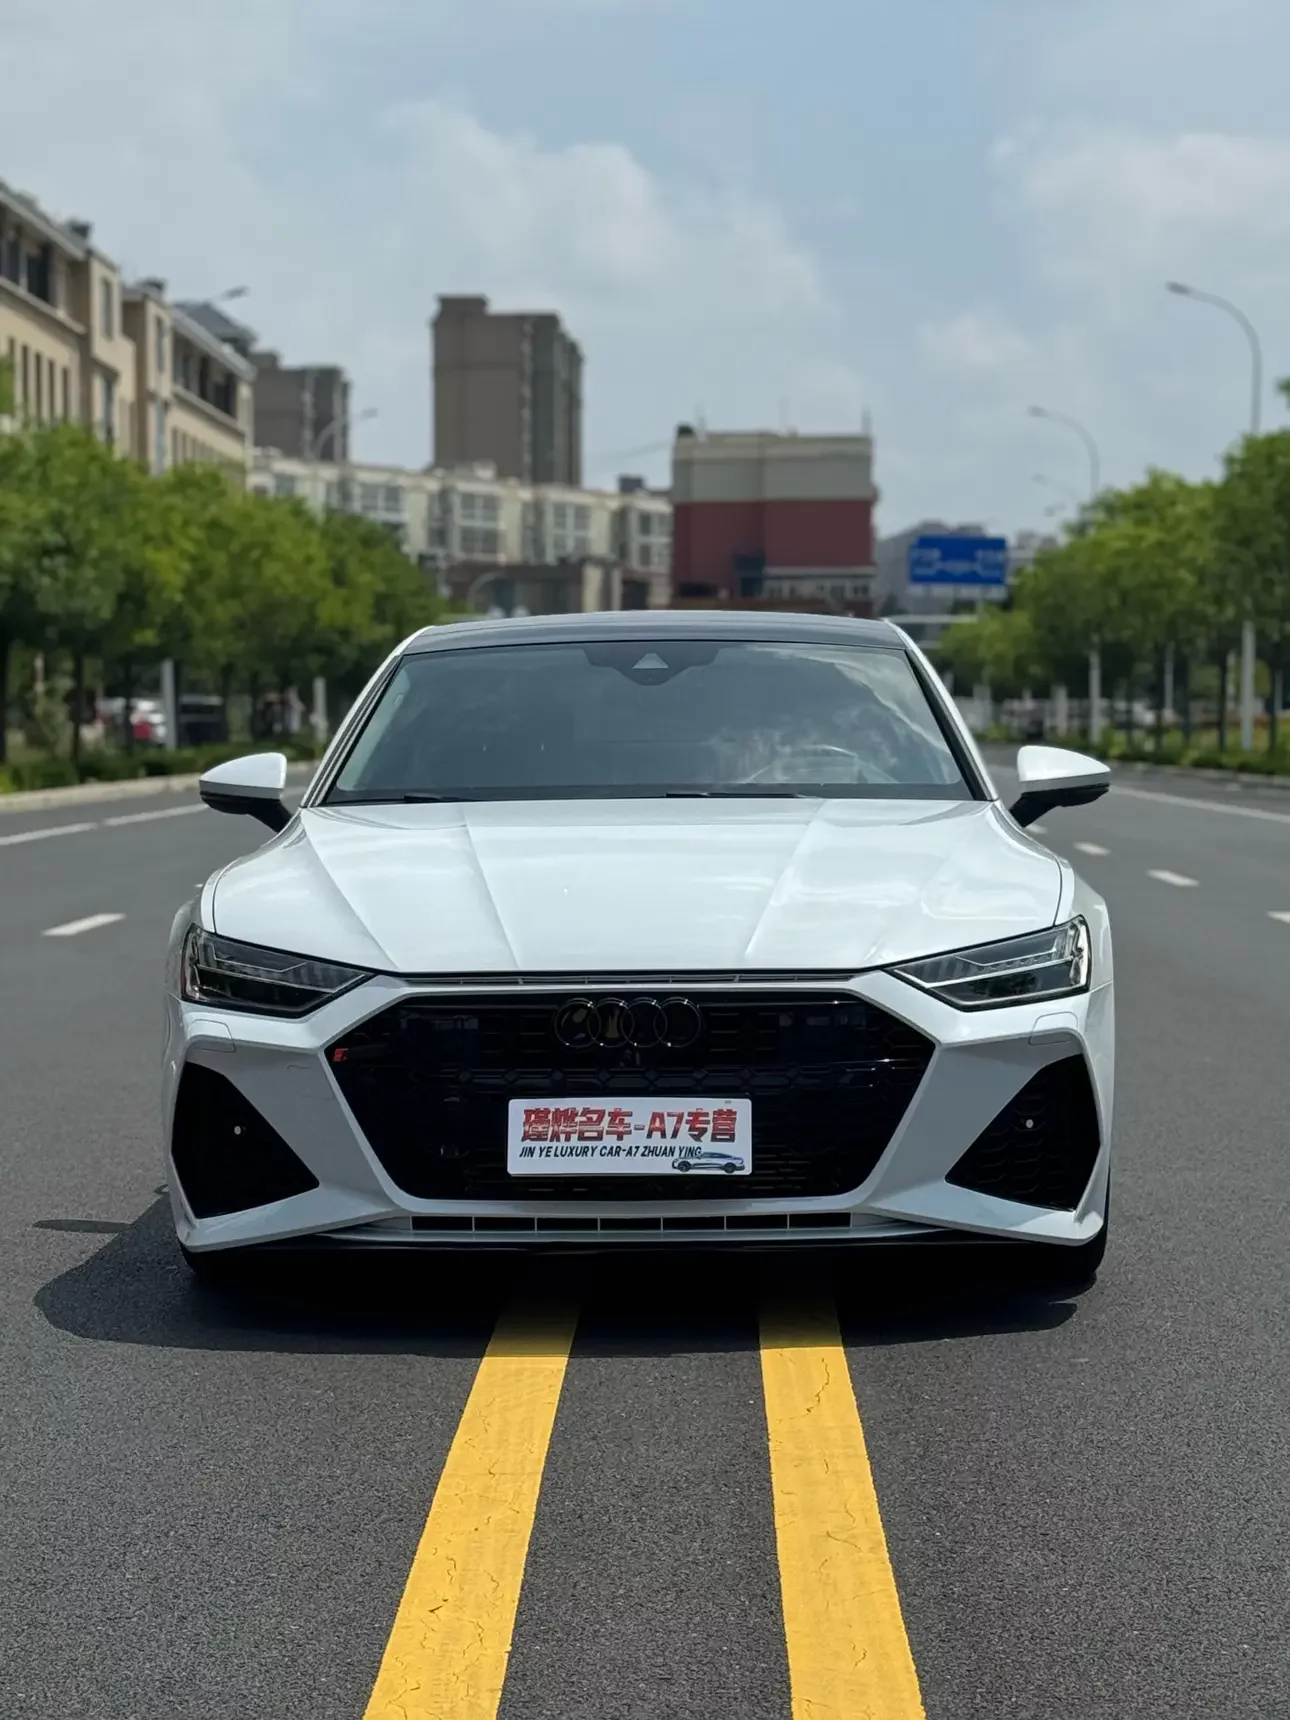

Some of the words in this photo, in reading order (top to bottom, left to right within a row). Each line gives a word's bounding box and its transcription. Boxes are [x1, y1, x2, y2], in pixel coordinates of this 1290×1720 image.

[519, 1146, 535, 1157] JIN
[538, 1146, 553, 1157] YE
[554, 1145, 598, 1157] LUXURY
[641, 1145, 676, 1157] ZHUAN
[678, 1145, 701, 1157] YING
